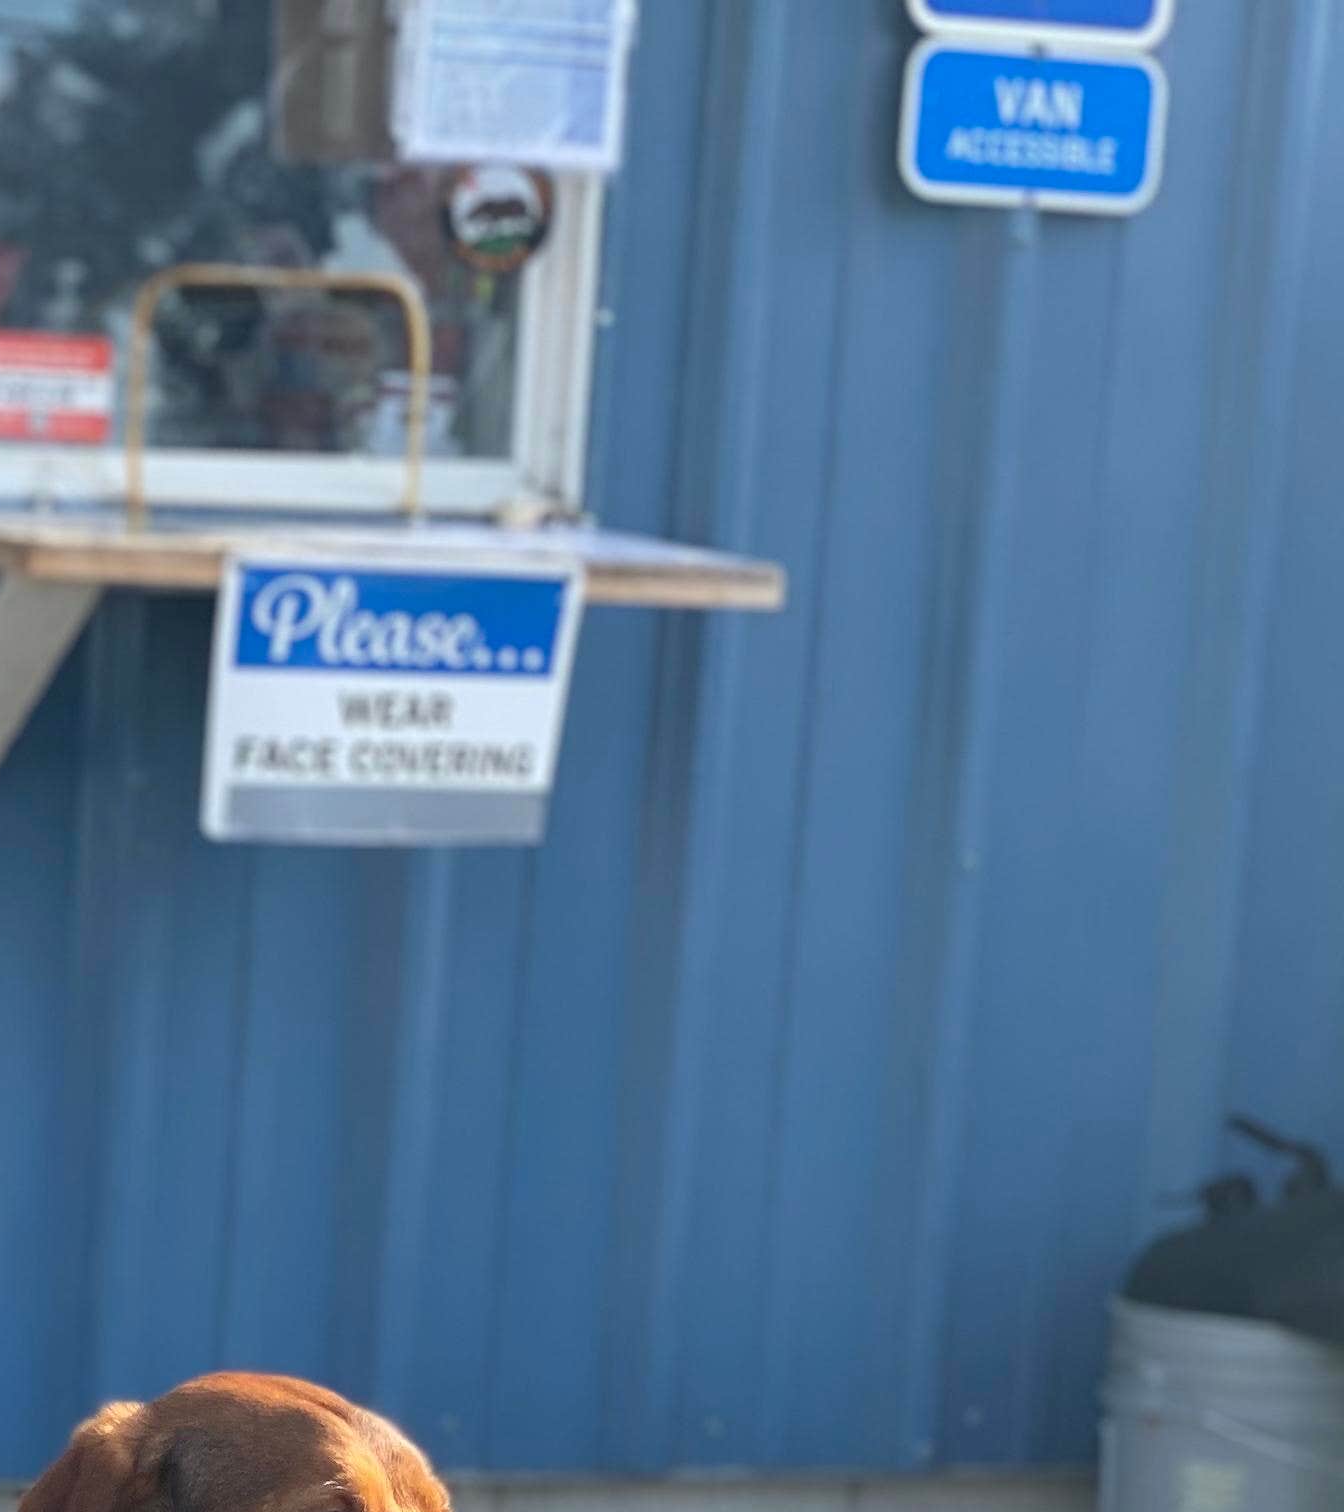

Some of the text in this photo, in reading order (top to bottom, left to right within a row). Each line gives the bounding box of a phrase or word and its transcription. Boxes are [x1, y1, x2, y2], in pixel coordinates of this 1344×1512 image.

[993, 75, 1084, 130] VAN
[946, 126, 1118, 176] ACCESSIBLE
[337, 689, 454, 728] WEAR
[233, 736, 536, 780] FACE COVERING
